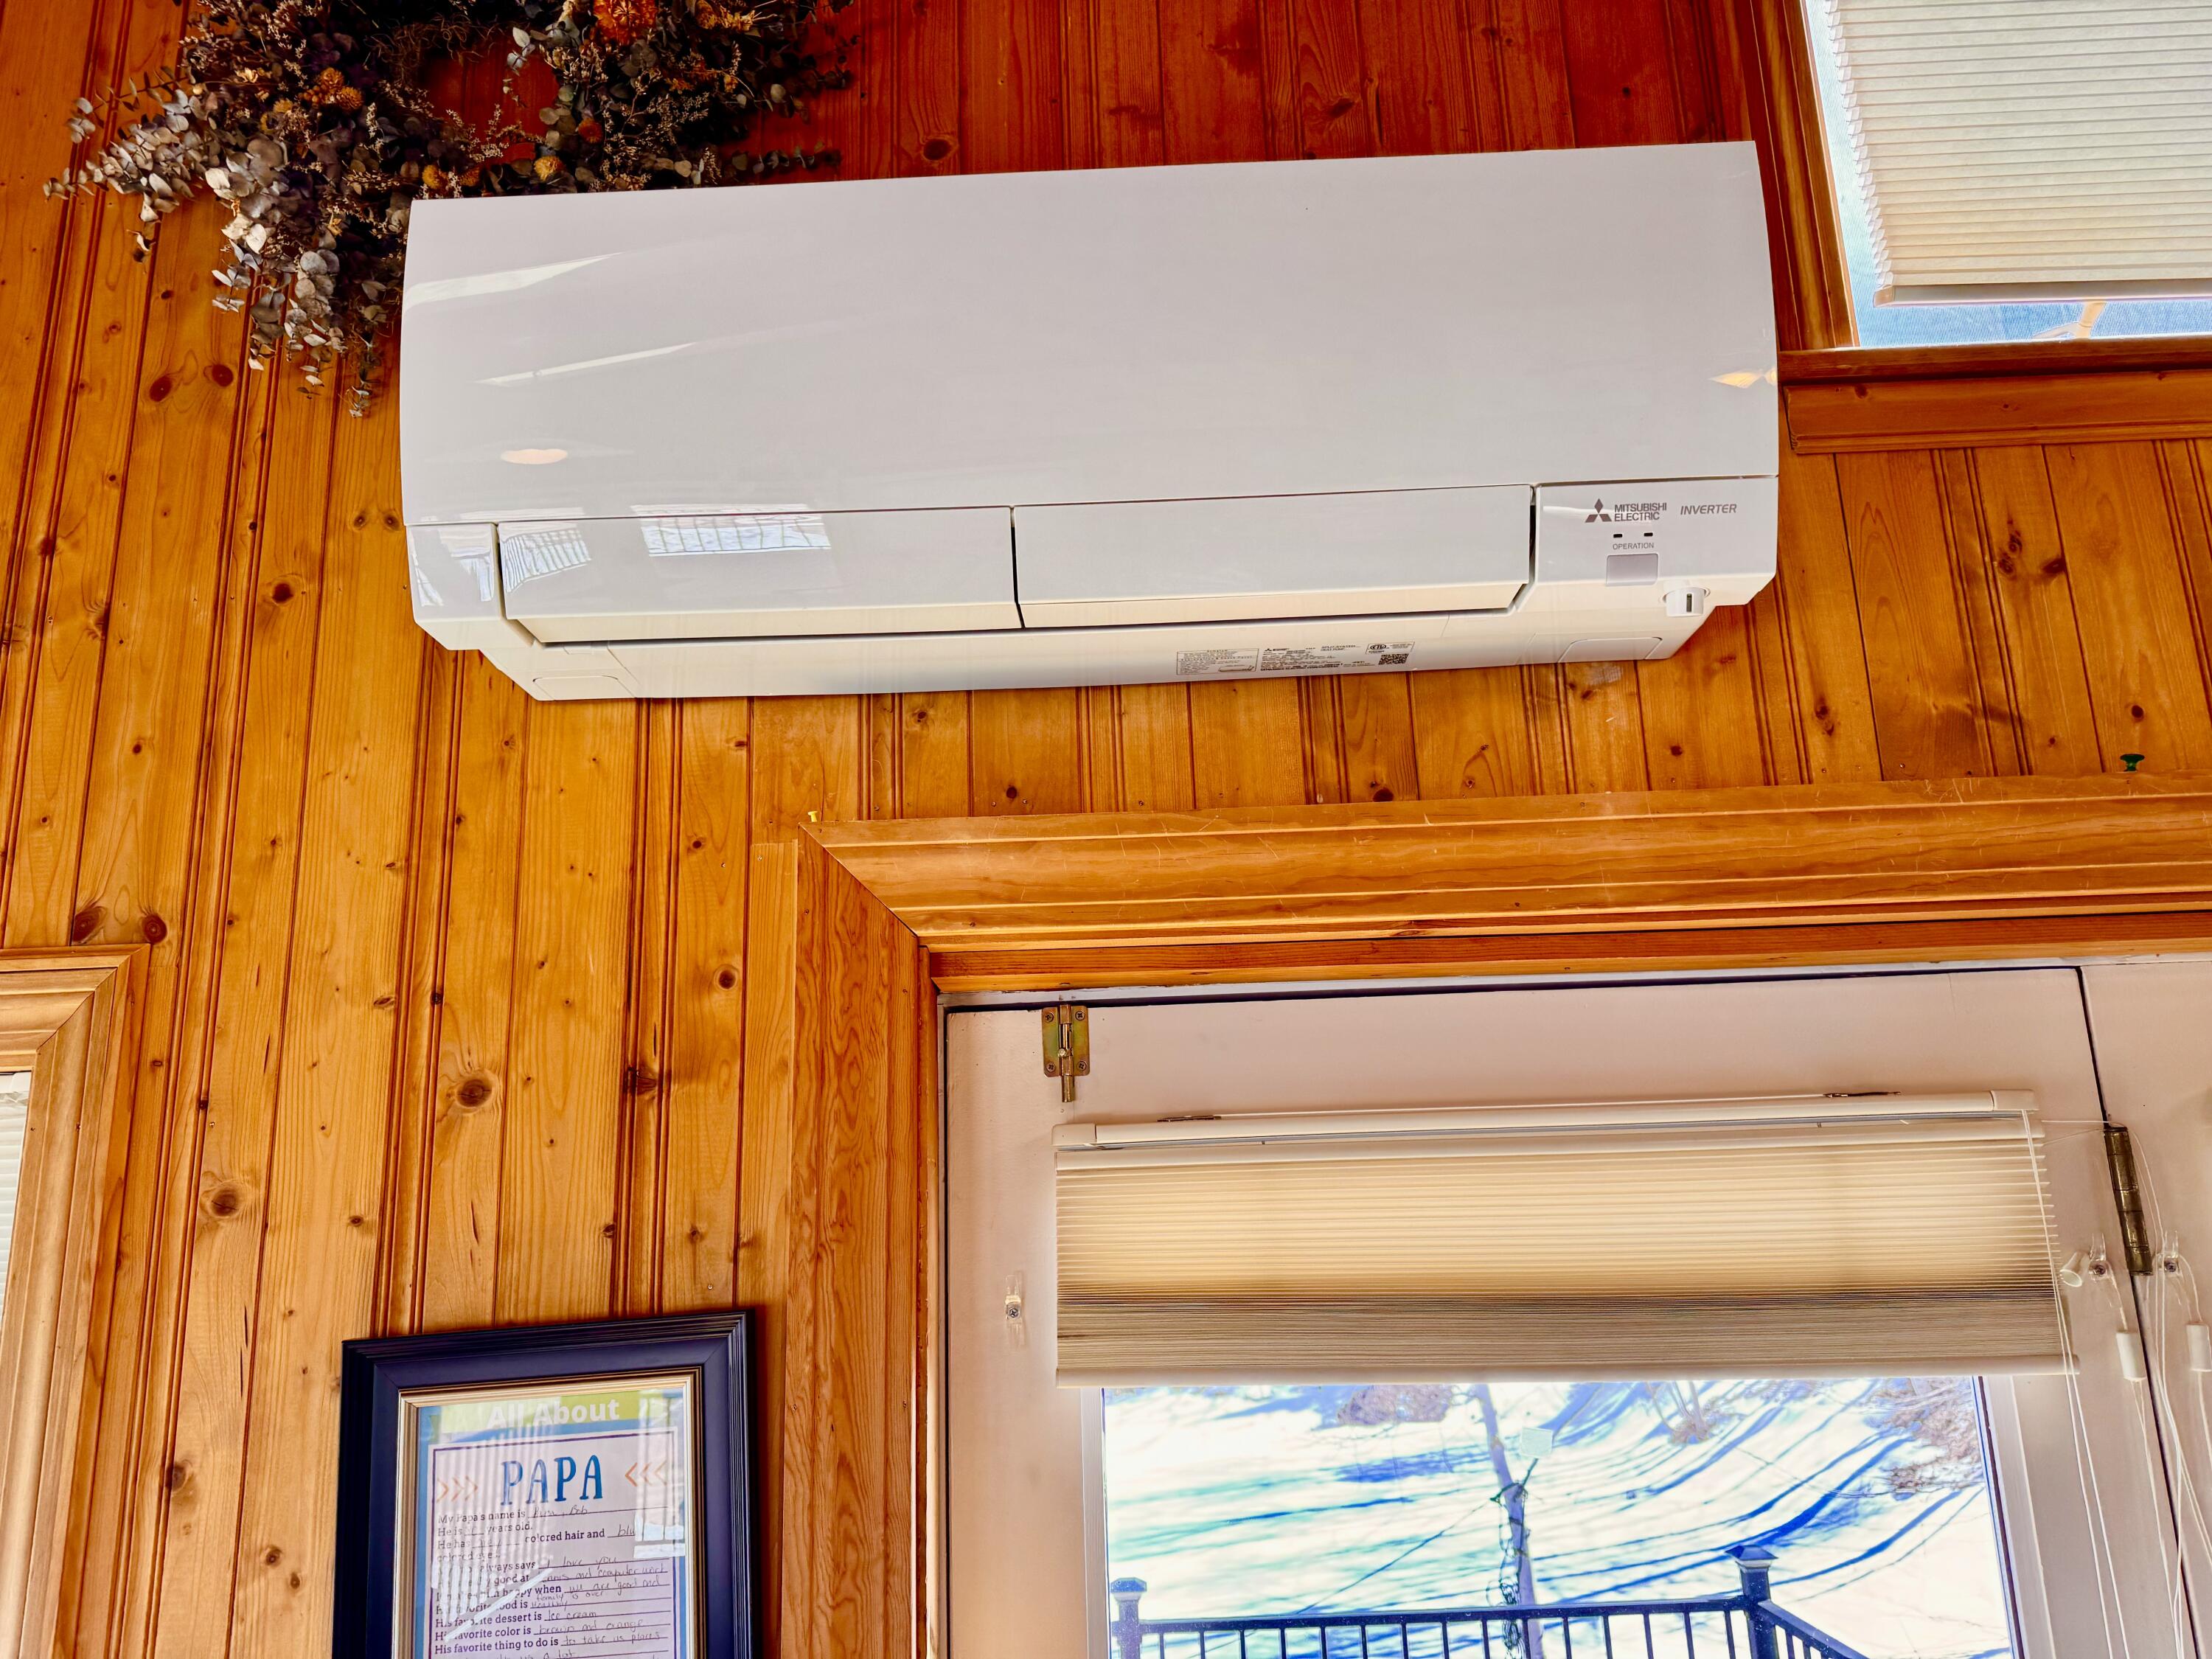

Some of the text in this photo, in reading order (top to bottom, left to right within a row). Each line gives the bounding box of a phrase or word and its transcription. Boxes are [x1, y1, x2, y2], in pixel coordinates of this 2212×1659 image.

[1614, 503, 1667, 512] MITSUBISHI
[1680, 504, 1737, 515] INVERTER
[1614, 512, 1660, 522] ELECTRIC
[1613, 542, 1655, 550] OPERATION
[486, 1399, 620, 1429] All About
[500, 1454, 603, 1506] PAPA
[488, 1512, 515, 1521] name
[518, 1509, 526, 1518] is
[565, 1529, 585, 1540] hair
[587, 1528, 605, 1539] and
[618, 1523, 636, 1536] blu
[535, 1584, 562, 1594] when
[520, 1599, 529, 1609] is
[495, 1613, 532, 1624] dessert
[534, 1611, 542, 1621] is
[453, 1628, 493, 1640] avorite
[495, 1627, 521, 1637] color
[523, 1625, 532, 1635] is
[435, 1637, 559, 1654] His favorite thing to do is
